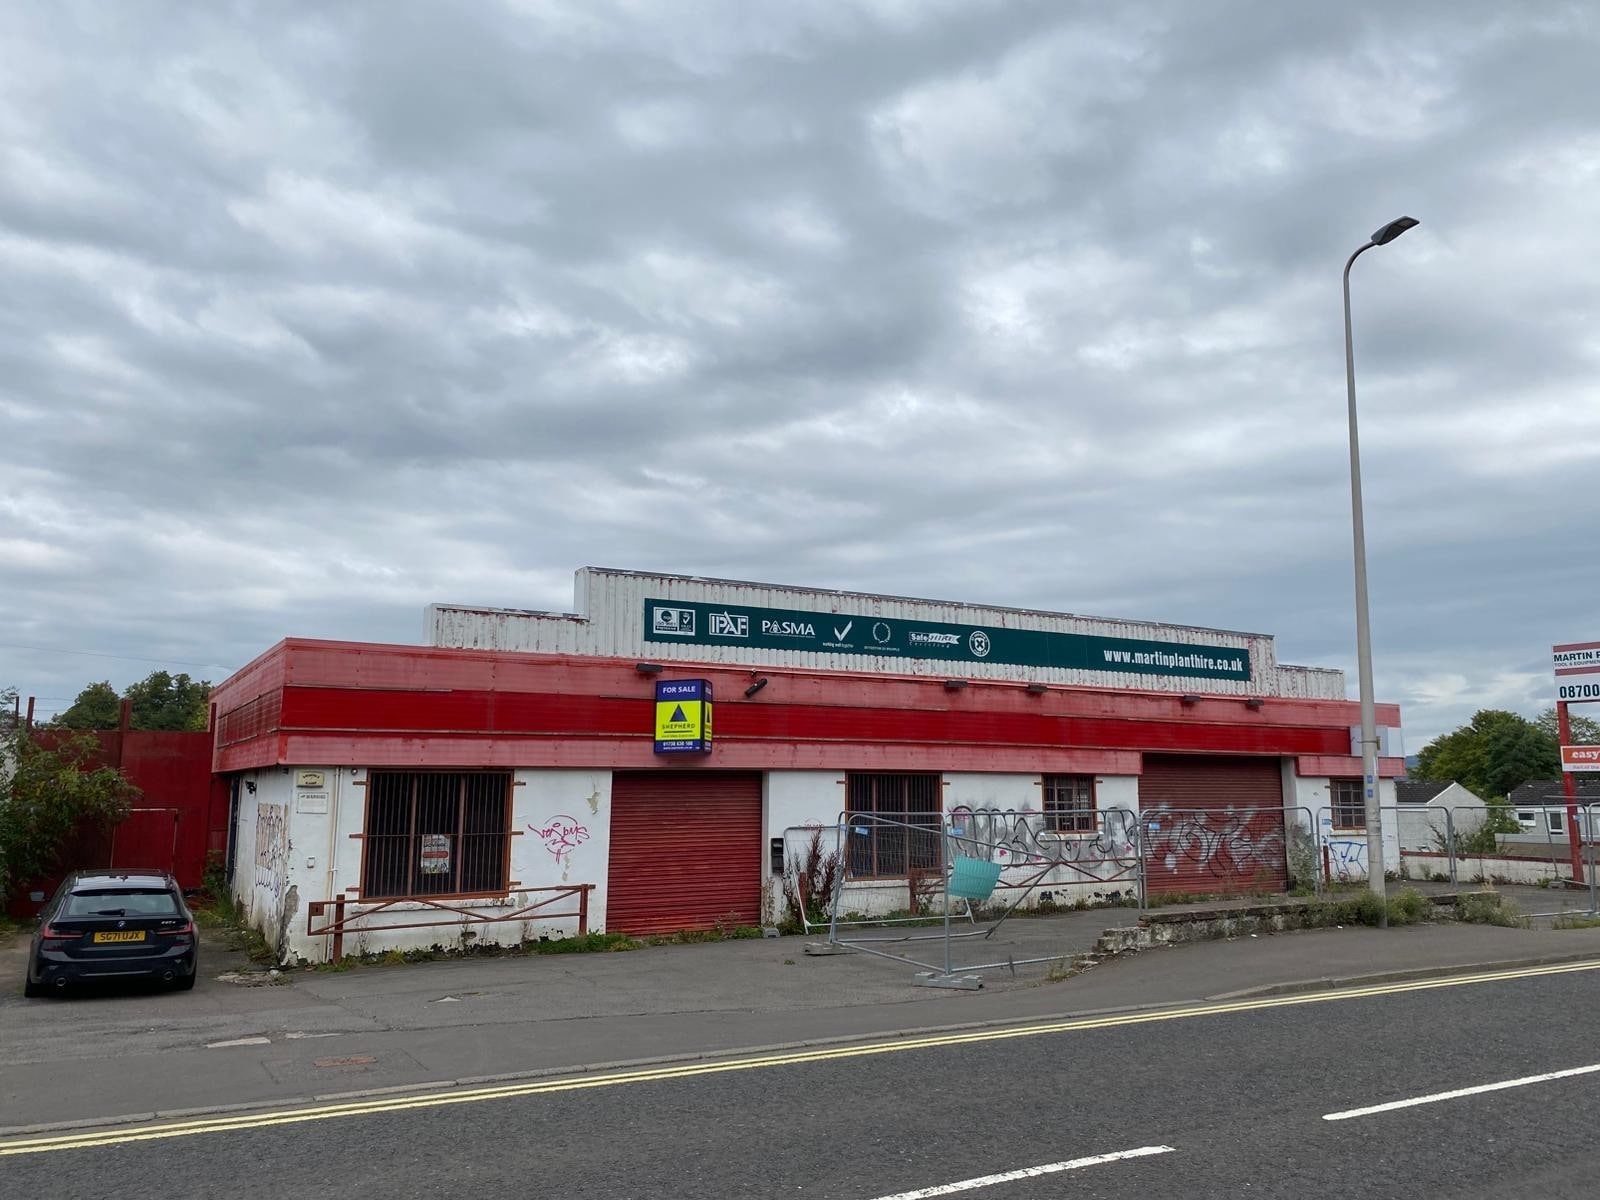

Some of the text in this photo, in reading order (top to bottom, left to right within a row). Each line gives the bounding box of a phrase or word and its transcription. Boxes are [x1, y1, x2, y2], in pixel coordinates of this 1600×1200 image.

[711, 611, 747, 634] IPAF
[762, 620, 816, 635] PASMA
[1103, 650, 1243, 672] www.martinplanthire.co.uk
[1553, 652, 1592, 661] MARTIN
[1559, 684, 1600, 698] 08700
[122, 932, 140, 940] UJX
